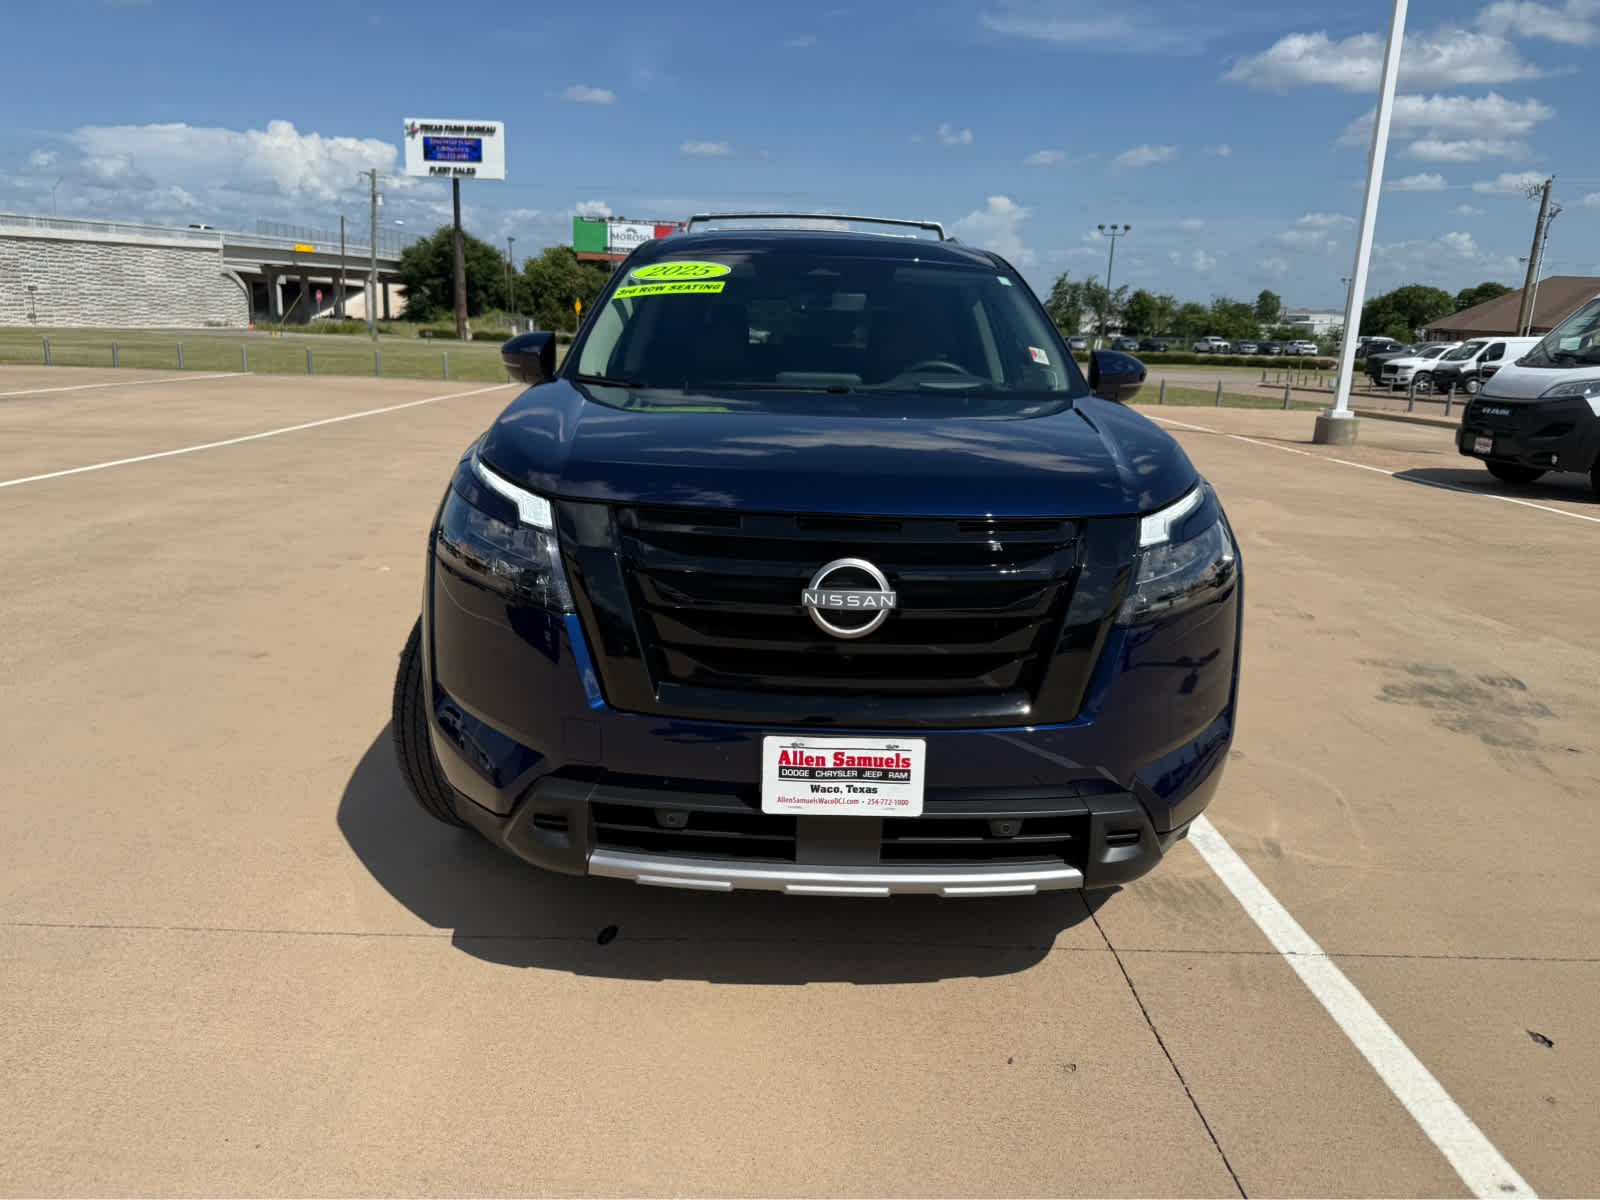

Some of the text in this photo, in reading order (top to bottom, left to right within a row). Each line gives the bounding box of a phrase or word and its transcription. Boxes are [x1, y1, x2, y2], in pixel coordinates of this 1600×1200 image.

[645, 265, 716, 277] 2025
[617, 283, 722, 295] 3rd ROW SEATING
[1482, 407, 1510, 416] RAM
[804, 592, 894, 607] NISSAN
[777, 750, 911, 769] Allen Samuels
[781, 768, 908, 780] DODGE CHRYSLER JEEP RAM
[810, 784, 878, 795] Waco, Texas
[777, 795, 860, 806] AllenSamuelsWacoDCJ.com
